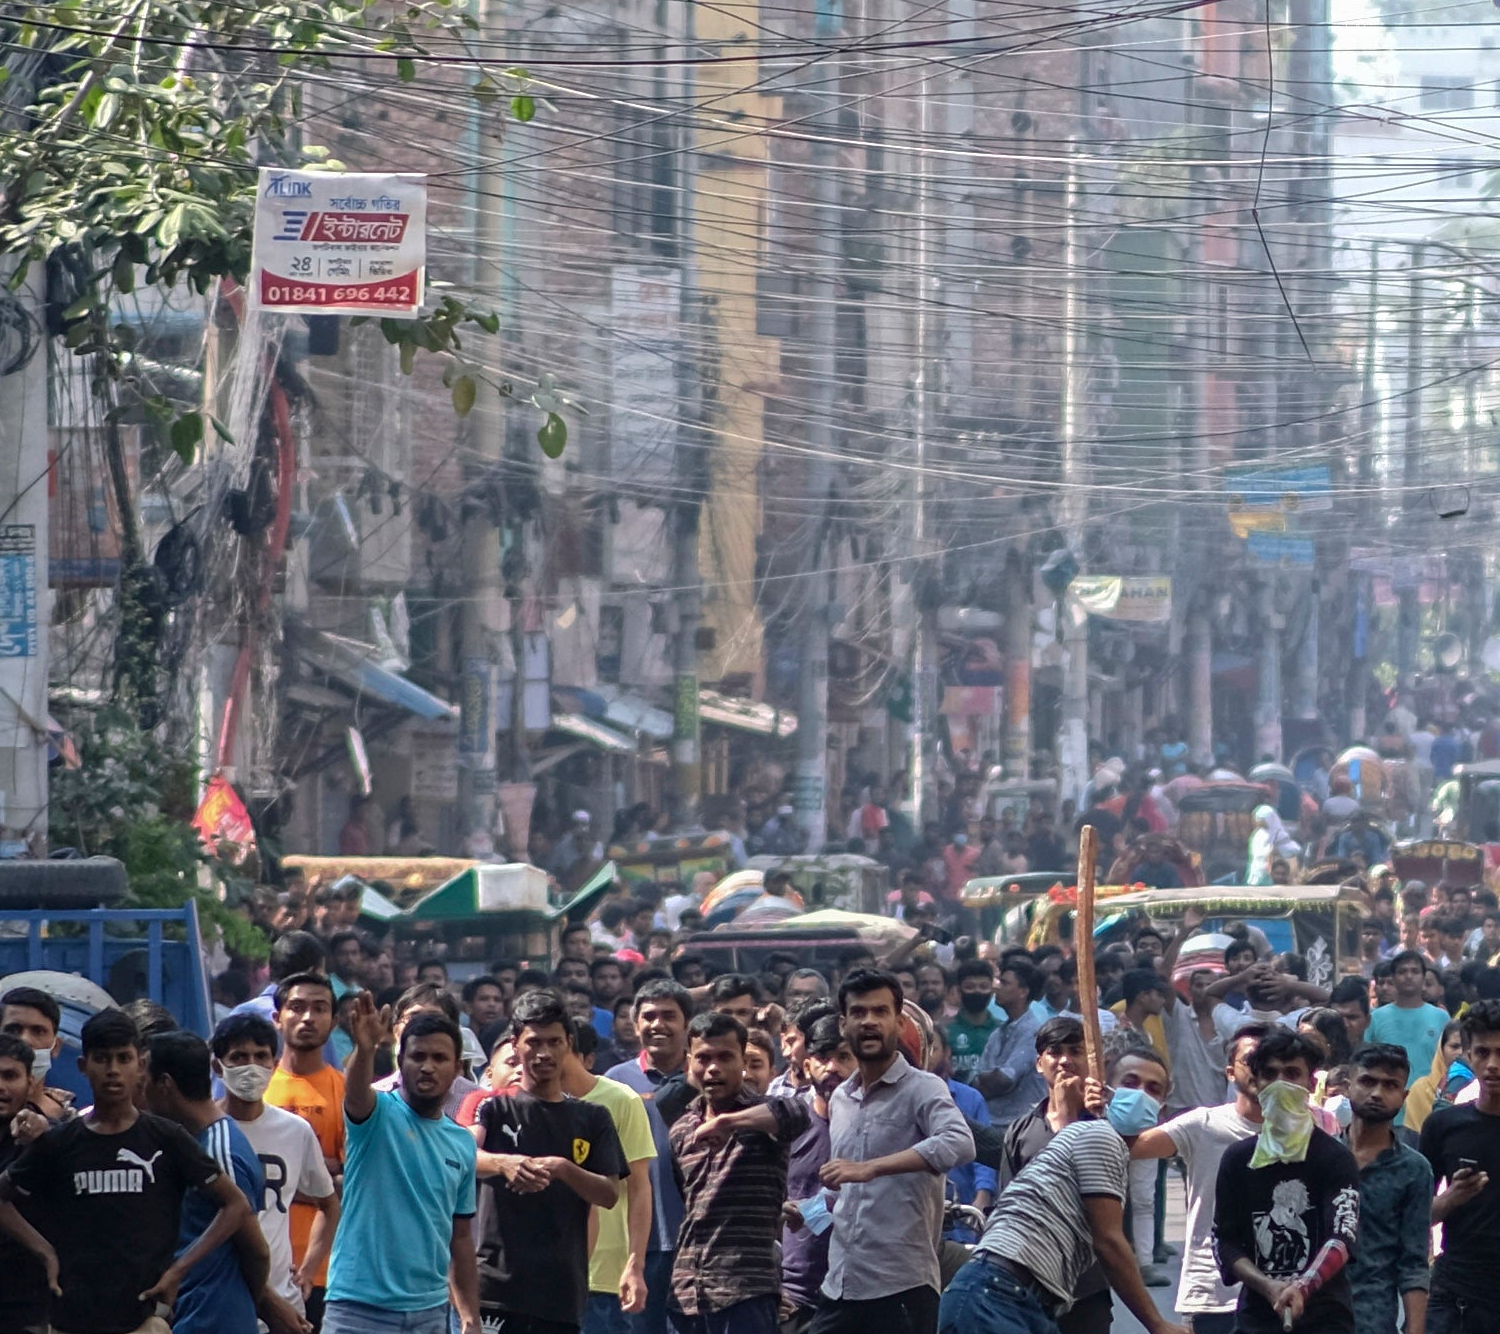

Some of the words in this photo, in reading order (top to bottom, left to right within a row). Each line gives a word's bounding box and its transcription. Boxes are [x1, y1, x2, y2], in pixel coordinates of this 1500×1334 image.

[323, 215, 403, 241] ইন্টারনেট
[291, 257, 312, 271] ২৪
[268, 286, 327, 302] 01841
[333, 286, 370, 301] 696
[373, 286, 411, 302] 442
[74, 1169, 144, 1195] PUMA
